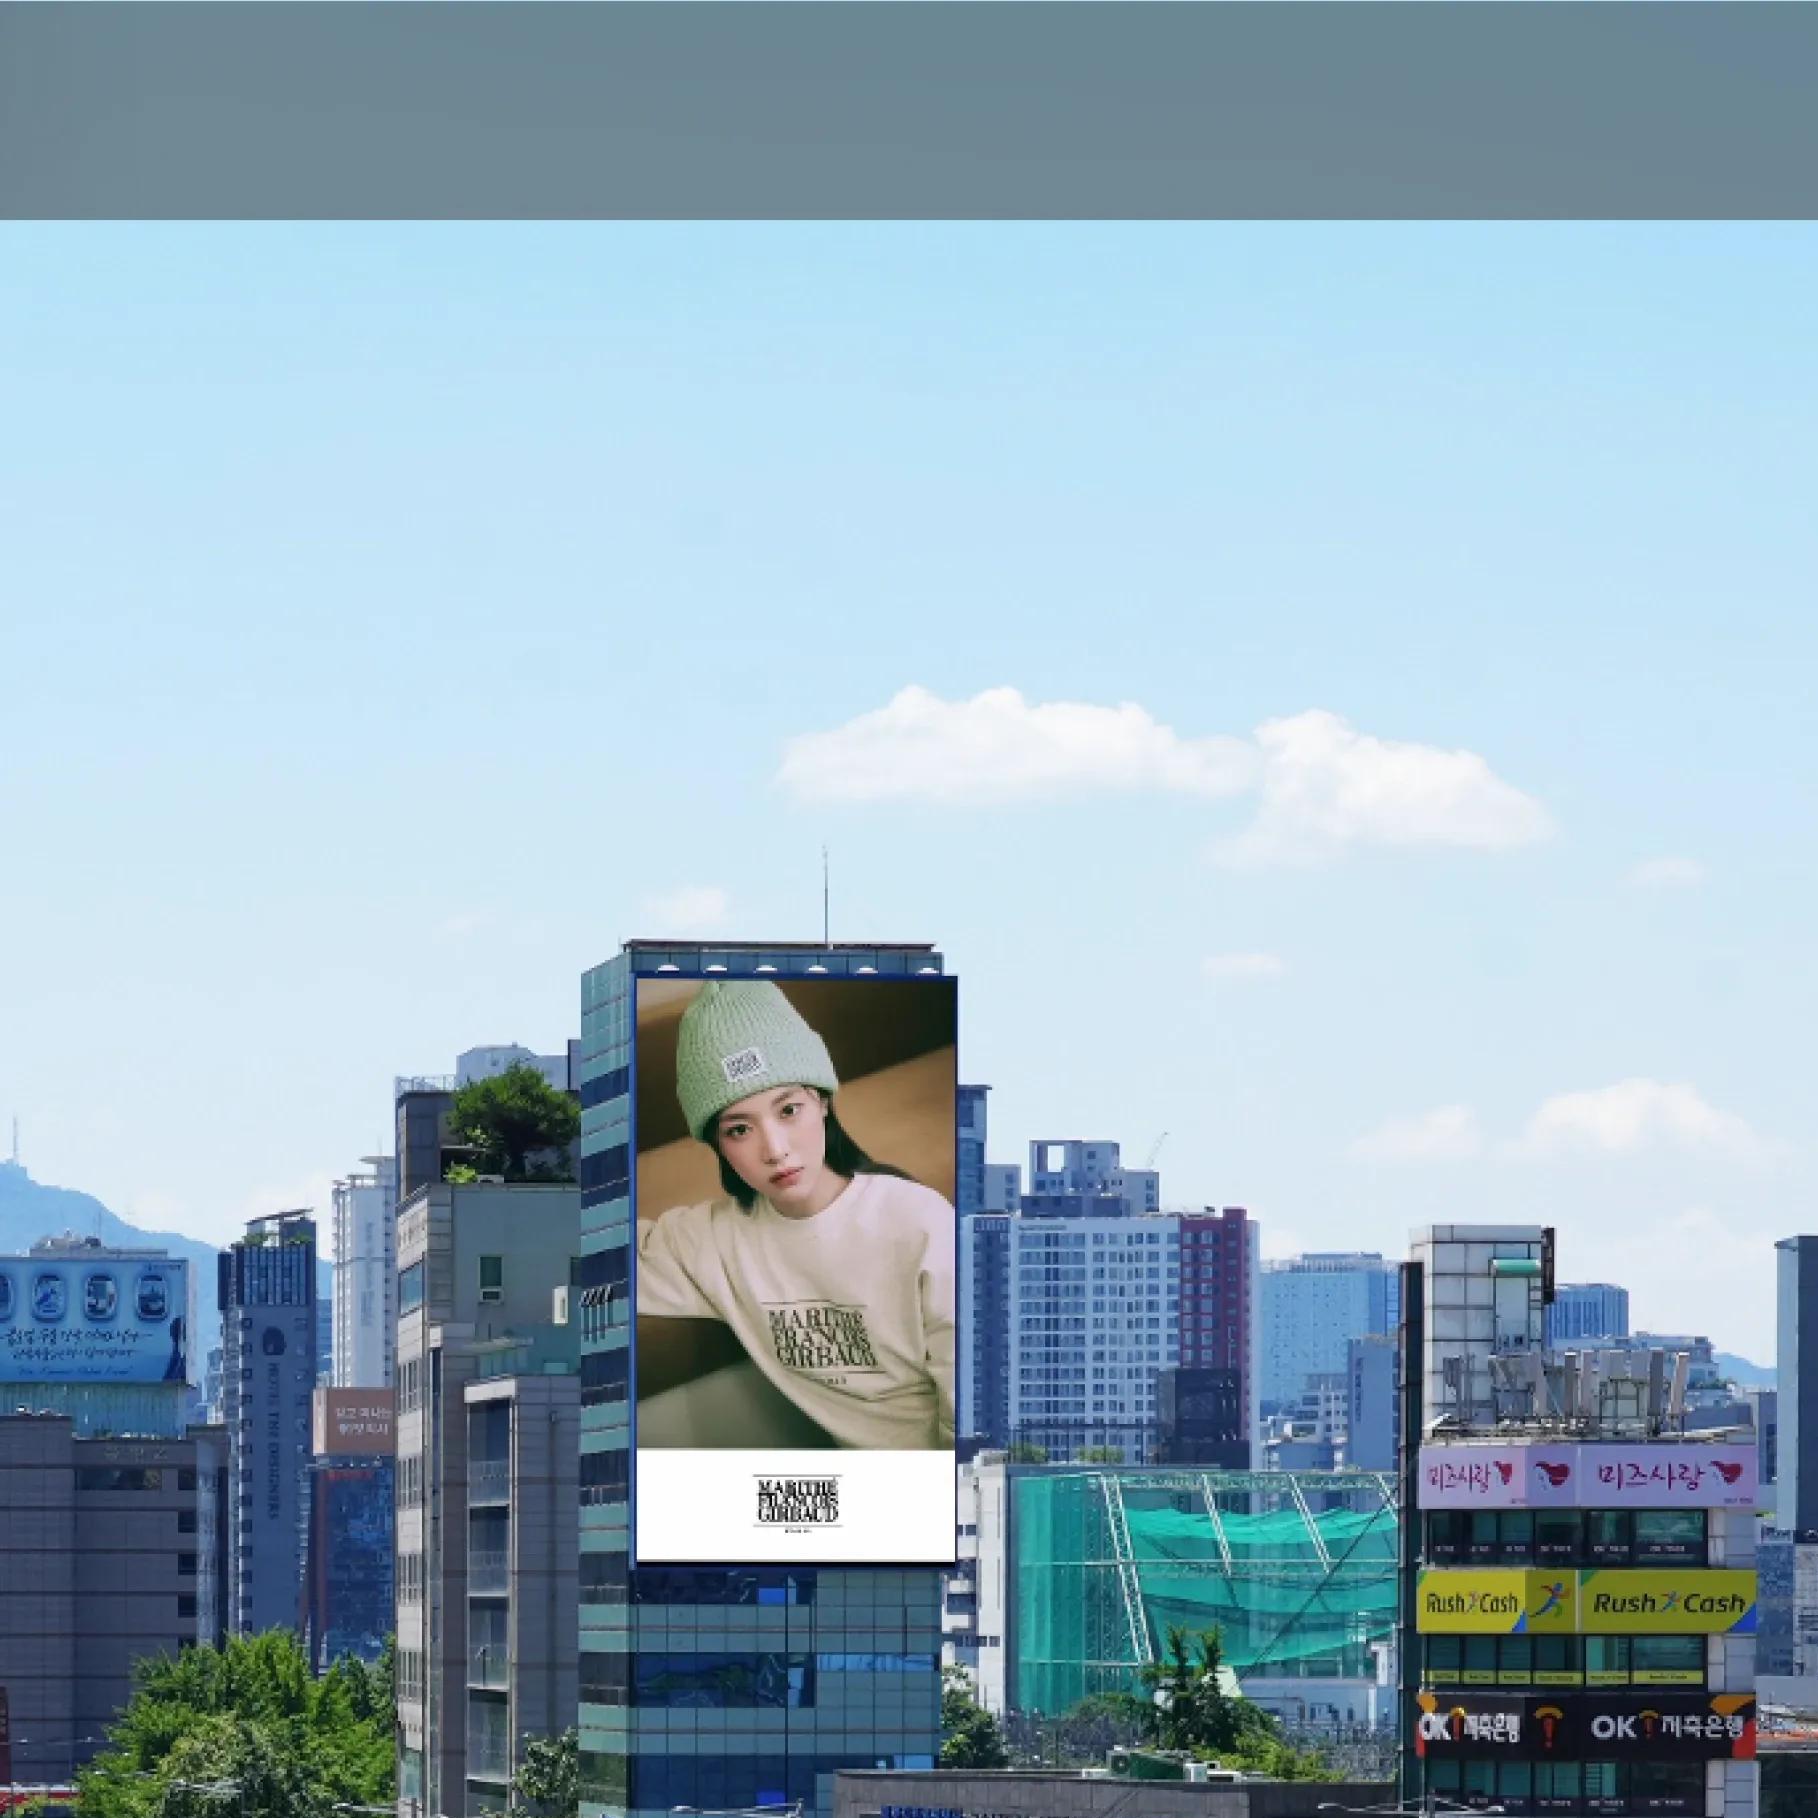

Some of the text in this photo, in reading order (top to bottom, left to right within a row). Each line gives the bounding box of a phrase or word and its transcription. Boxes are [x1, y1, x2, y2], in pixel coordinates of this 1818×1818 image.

[1429, 1463, 1490, 1493] 미즈사랑
[1598, 1460, 1704, 1493] 미즈사랑
[1426, 1593, 1518, 1614] Rush Cash
[1593, 1592, 1746, 1613] Rush Cash
[1590, 1713, 1744, 1739] OK 저축은행
